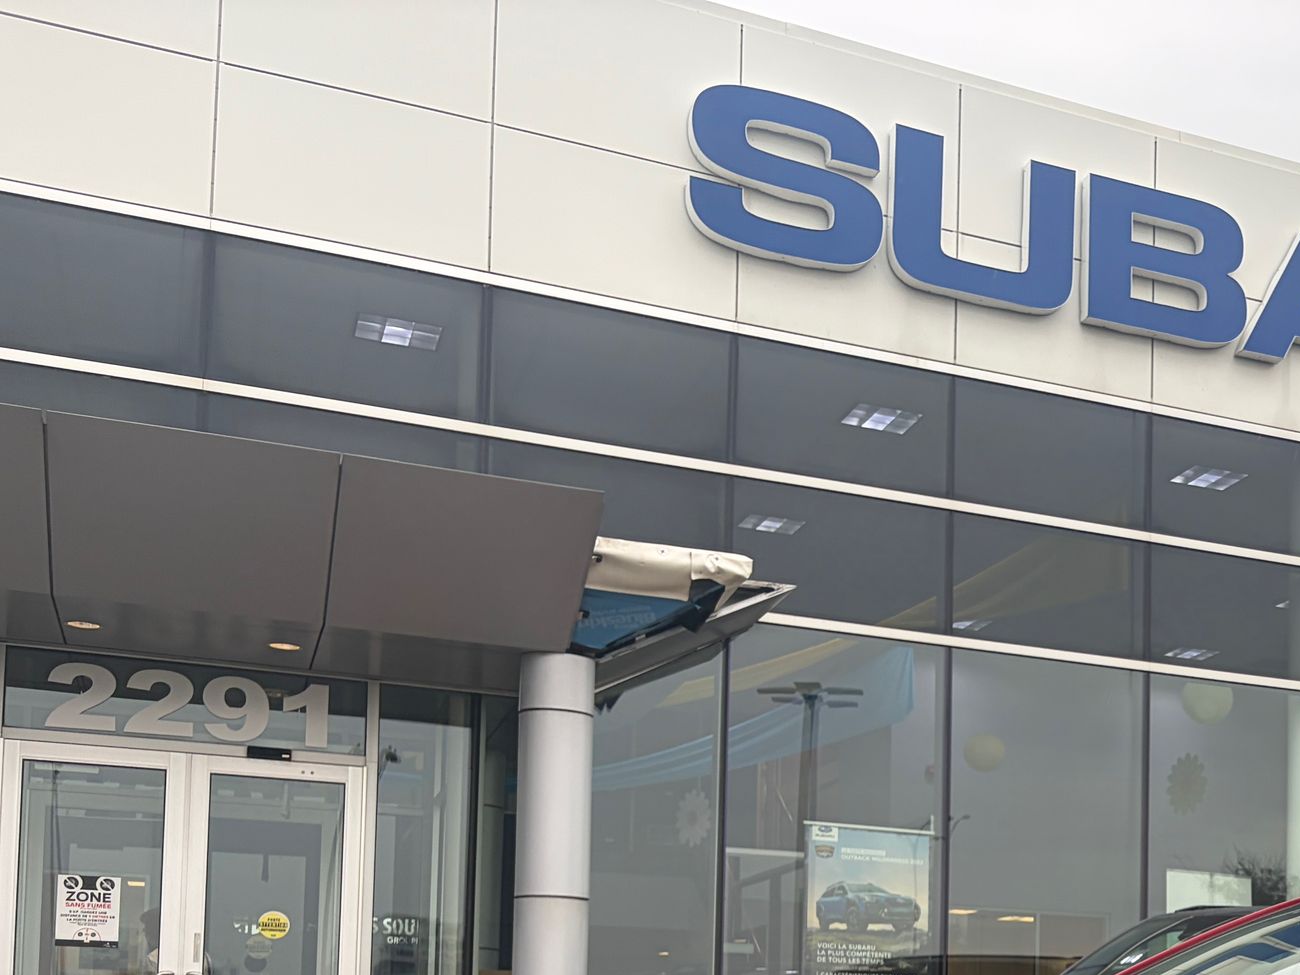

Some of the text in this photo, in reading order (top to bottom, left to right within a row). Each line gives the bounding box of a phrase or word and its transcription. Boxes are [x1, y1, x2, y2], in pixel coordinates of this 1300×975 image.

[45, 662, 330, 749] 2291
[66, 891, 111, 903] ZONE
[848, 943, 876, 951] SUBARU
[827, 949, 845, 957] PLUS
[828, 956, 847, 964] TOUS
[848, 957, 860, 965] LES
